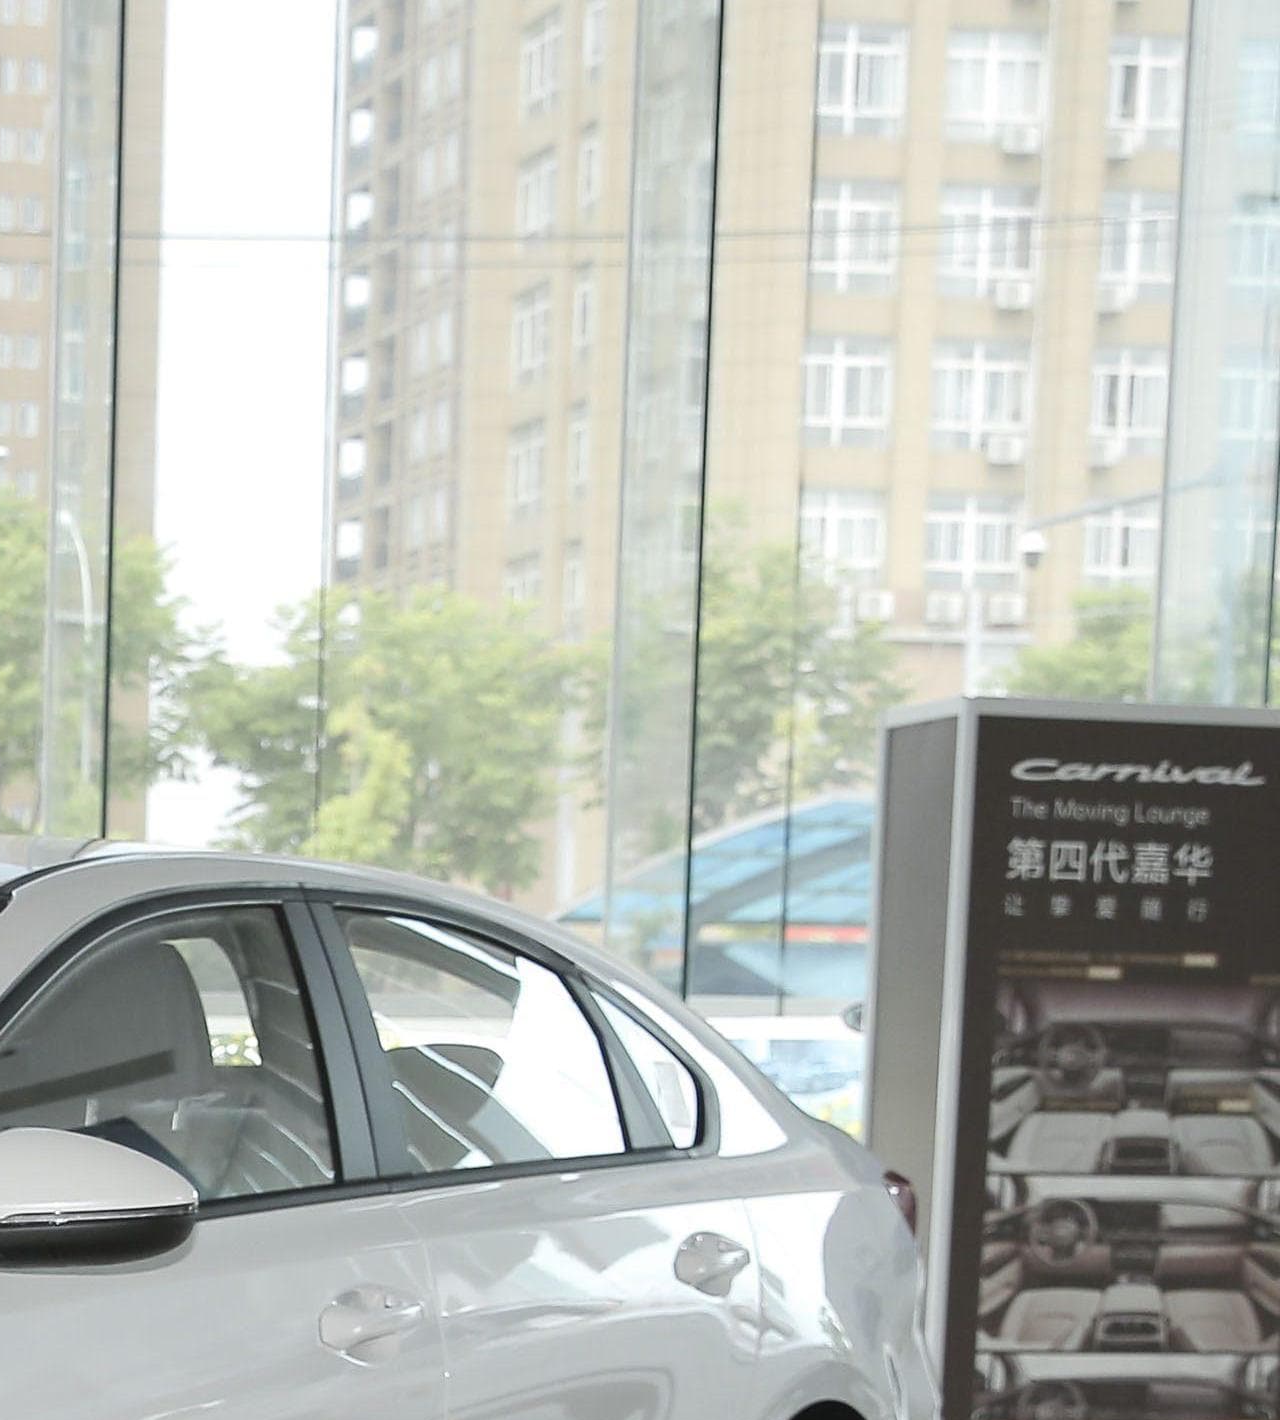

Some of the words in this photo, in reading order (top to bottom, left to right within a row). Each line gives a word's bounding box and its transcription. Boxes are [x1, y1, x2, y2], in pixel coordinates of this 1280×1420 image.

[1010, 757, 1267, 787] Carnival
[1010, 797, 1049, 820] The
[1053, 799, 1131, 827] Moving
[1133, 802, 1212, 829] Lounge
[1005, 836, 1215, 887] 第四代嘉华
